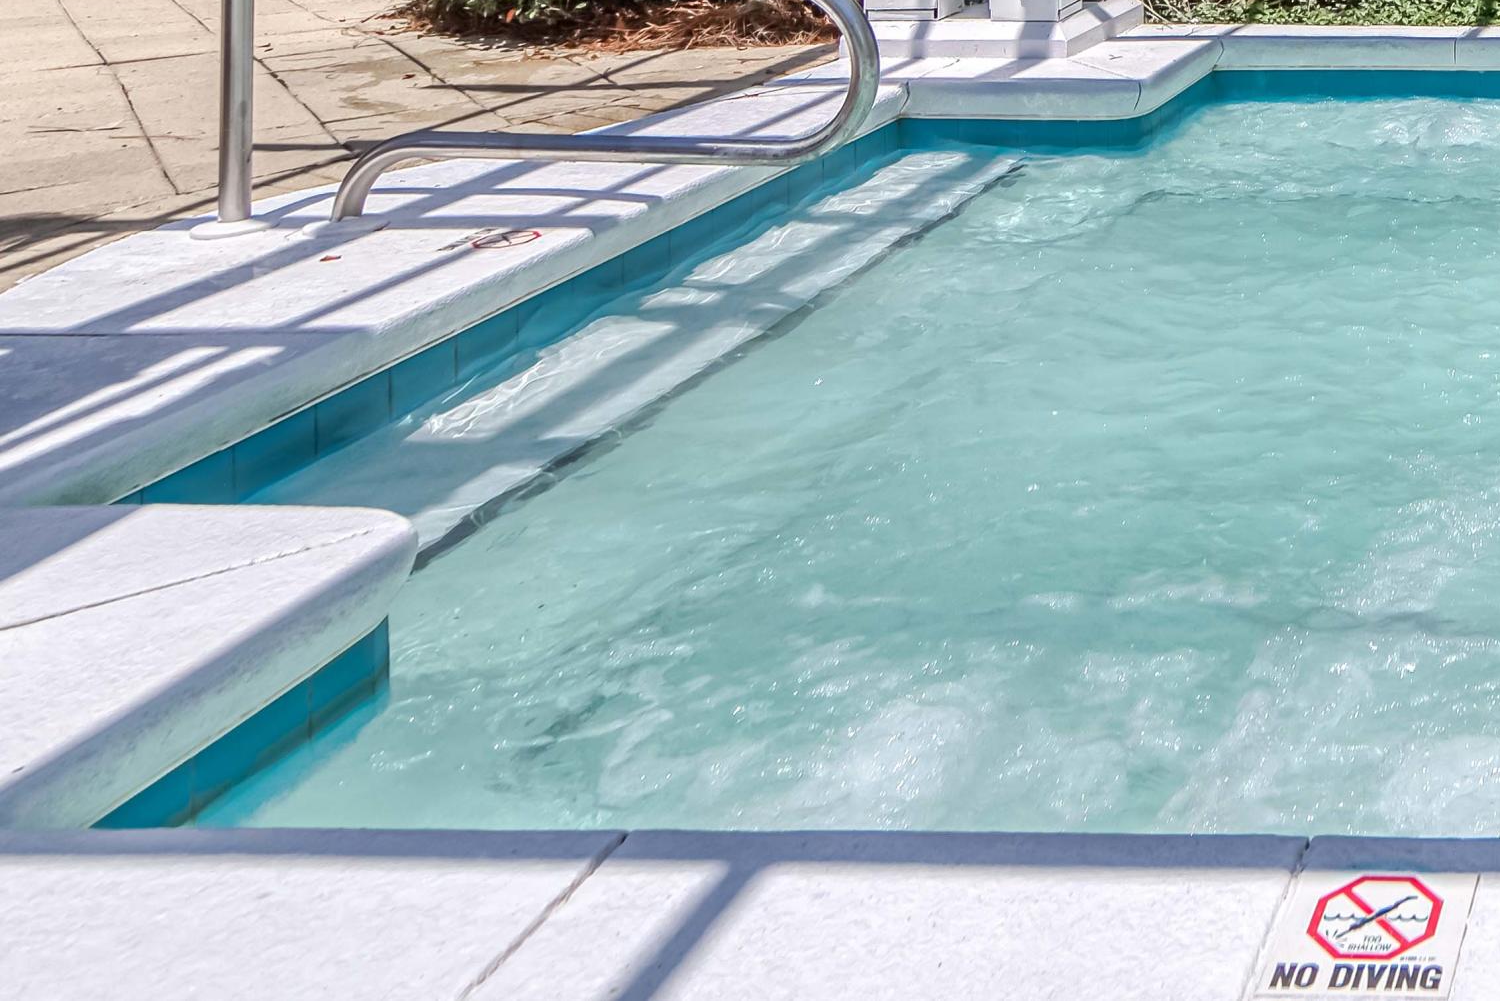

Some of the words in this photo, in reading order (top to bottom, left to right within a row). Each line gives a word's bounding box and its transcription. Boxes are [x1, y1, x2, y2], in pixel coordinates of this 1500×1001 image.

[1363, 935, 1381, 943] TOO
[1268, 962, 1319, 989] NO
[1327, 963, 1443, 991] DIVING
